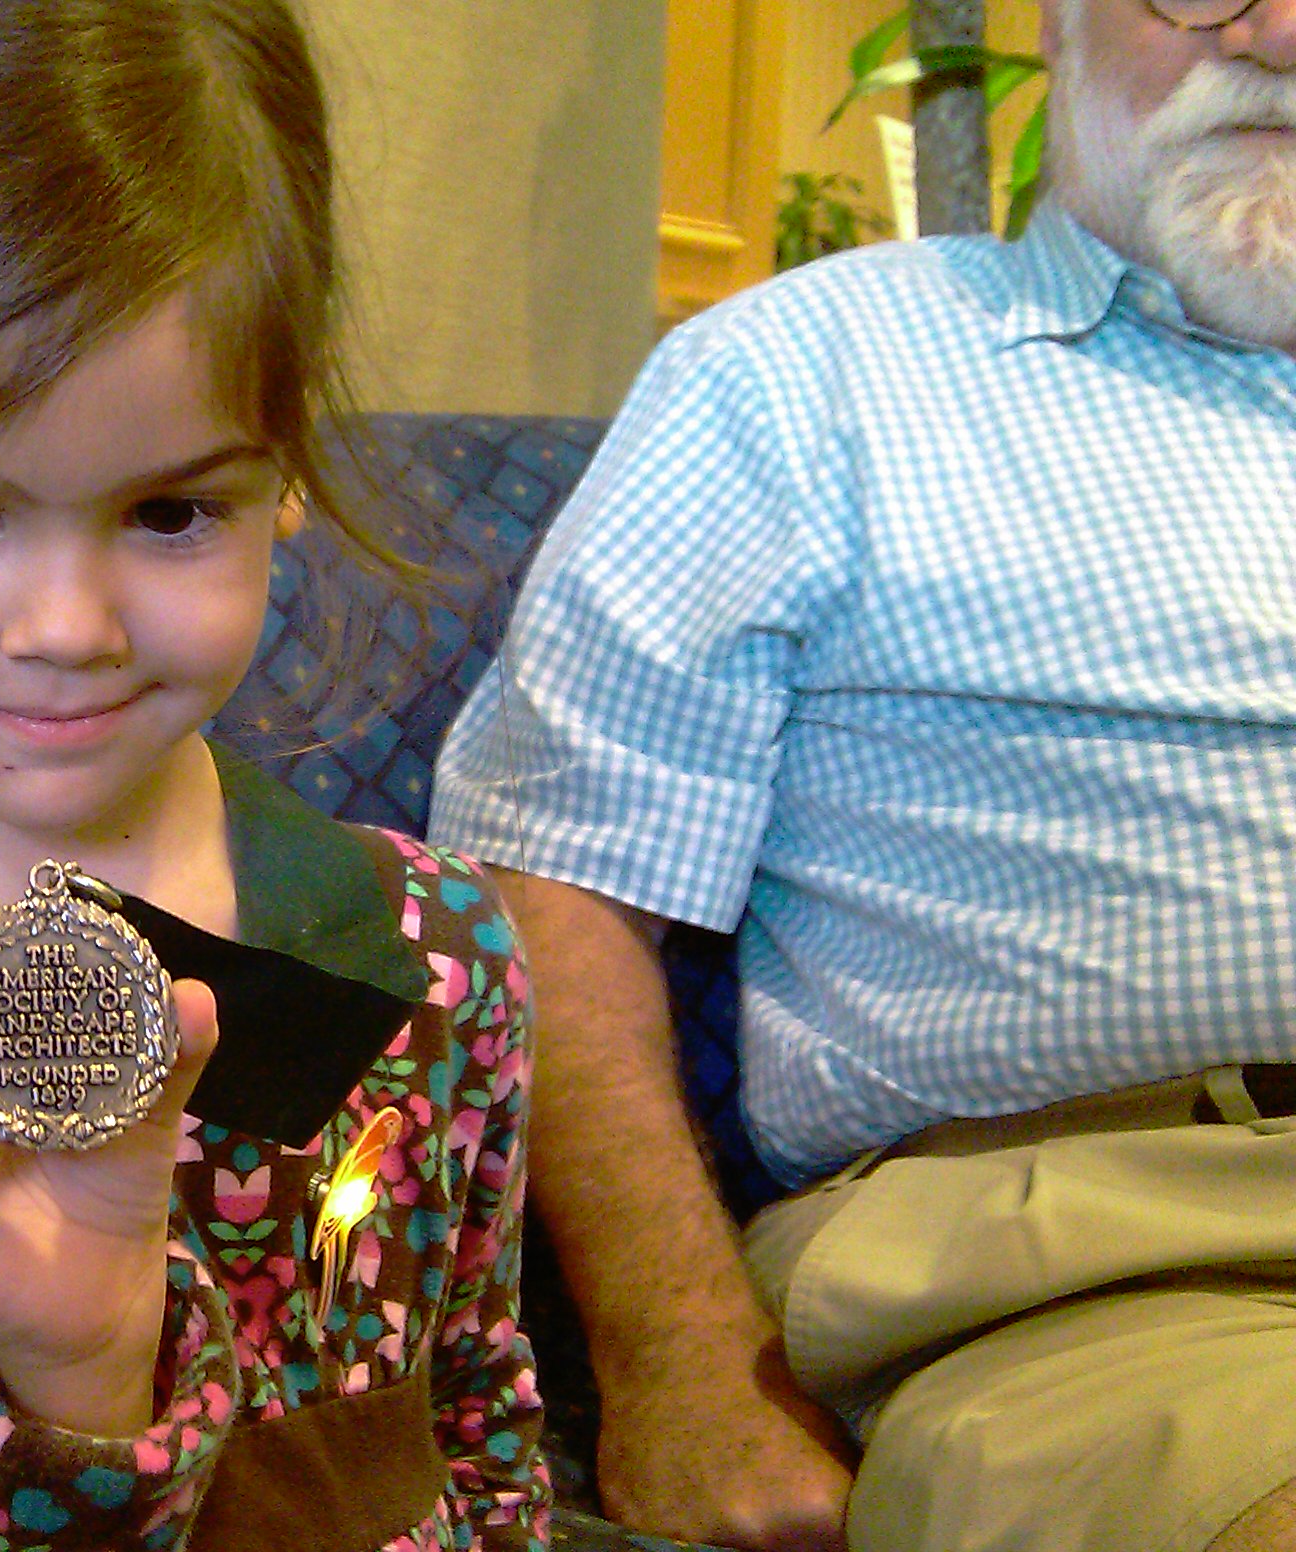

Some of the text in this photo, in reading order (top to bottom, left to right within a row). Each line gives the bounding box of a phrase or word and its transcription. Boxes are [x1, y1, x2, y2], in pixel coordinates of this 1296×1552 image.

[26, 943, 78, 967] THE
[97, 986, 133, 1010] OF
[0, 1063, 121, 1087] FOUNDED
[31, 1084, 87, 1110] 1899
